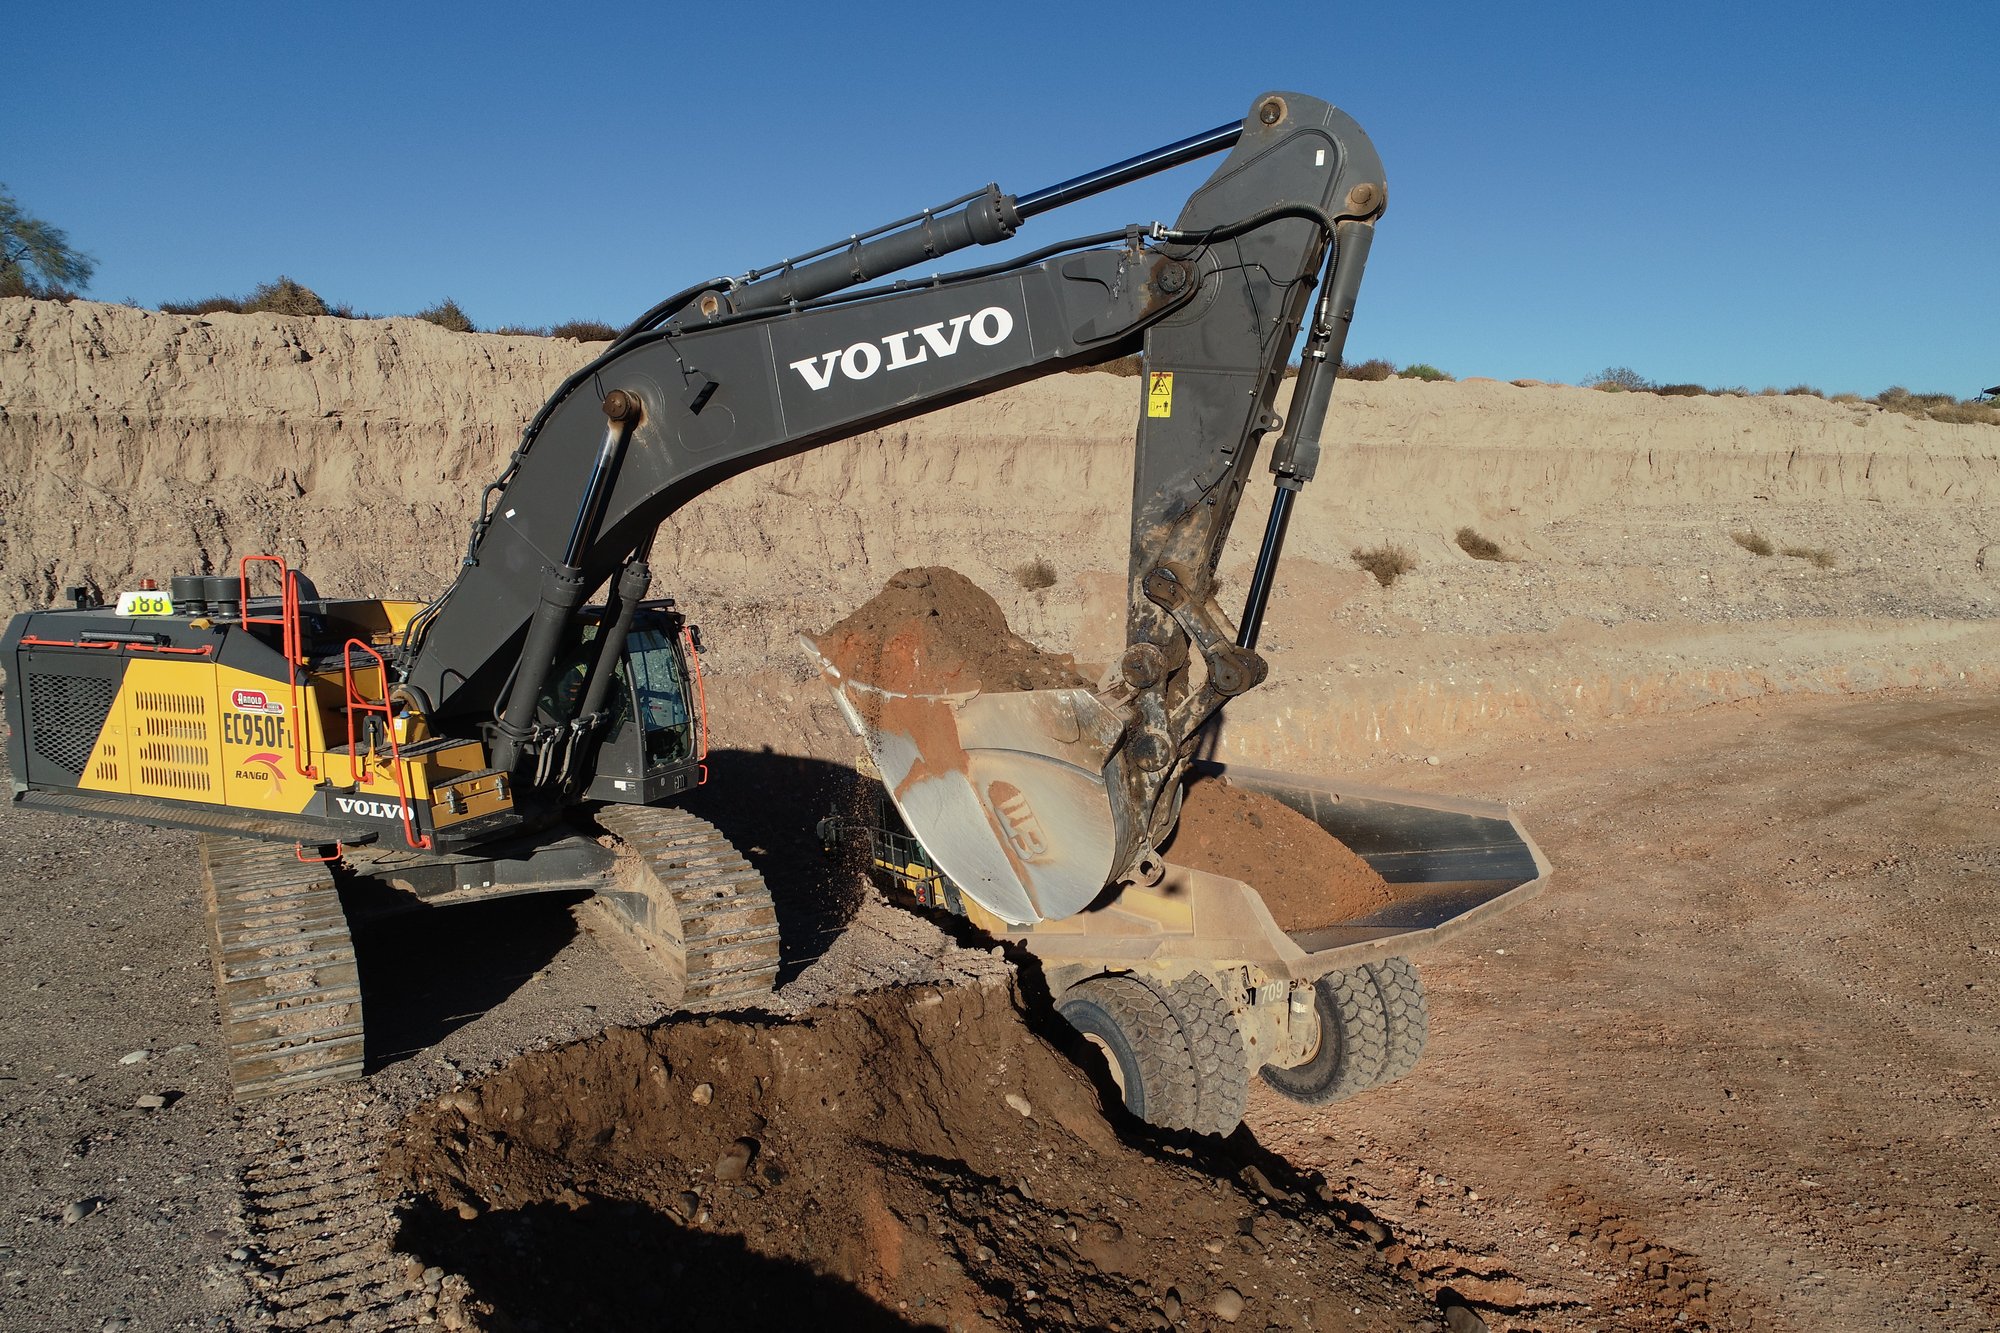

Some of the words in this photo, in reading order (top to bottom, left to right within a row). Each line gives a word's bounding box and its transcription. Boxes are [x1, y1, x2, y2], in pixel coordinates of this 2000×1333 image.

[789, 306, 1014, 391] VOLVO
[235, 770, 269, 780] RANGO
[335, 797, 415, 821] VOLVO
[1261, 980, 1284, 1005] 709
